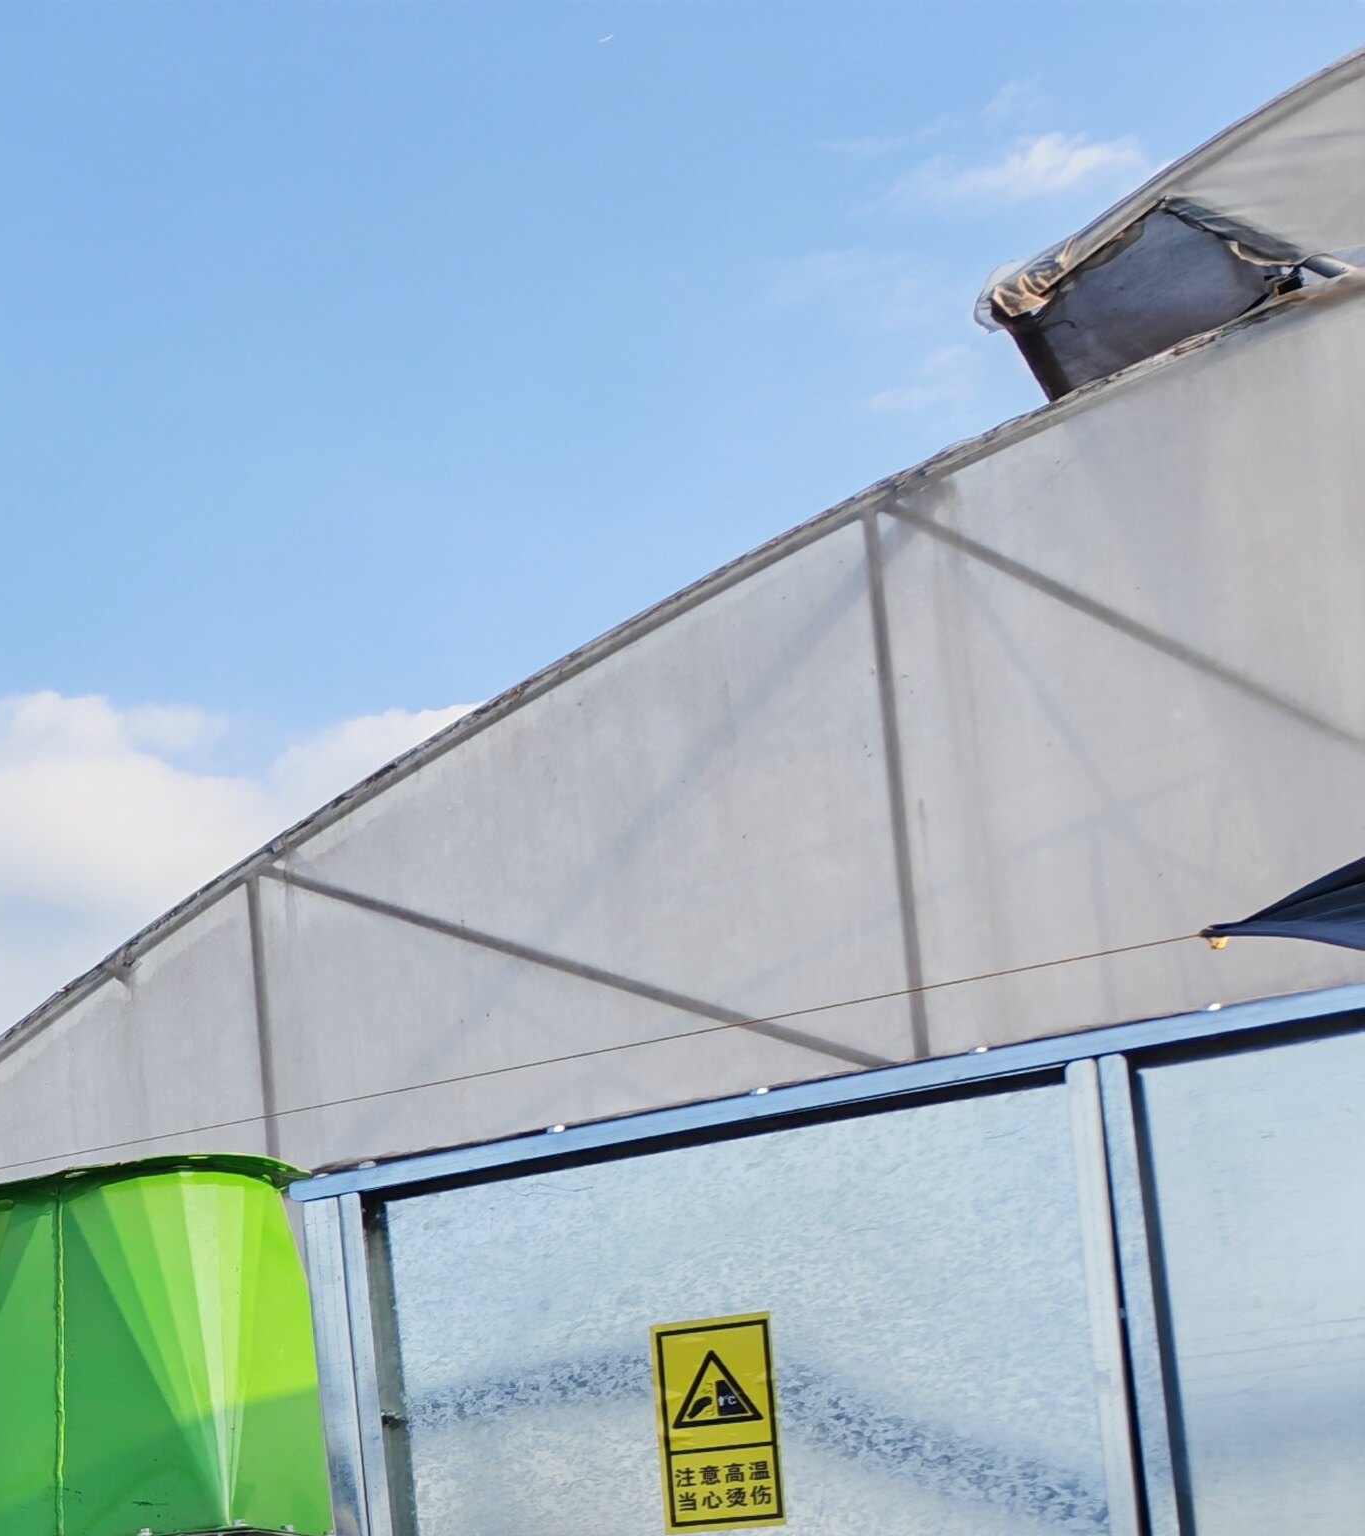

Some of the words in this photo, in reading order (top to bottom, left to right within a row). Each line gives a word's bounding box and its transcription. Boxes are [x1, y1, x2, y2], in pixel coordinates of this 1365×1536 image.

[675, 1461, 771, 1488] 注意高温
[678, 1485, 772, 1512] 当心烫伤
